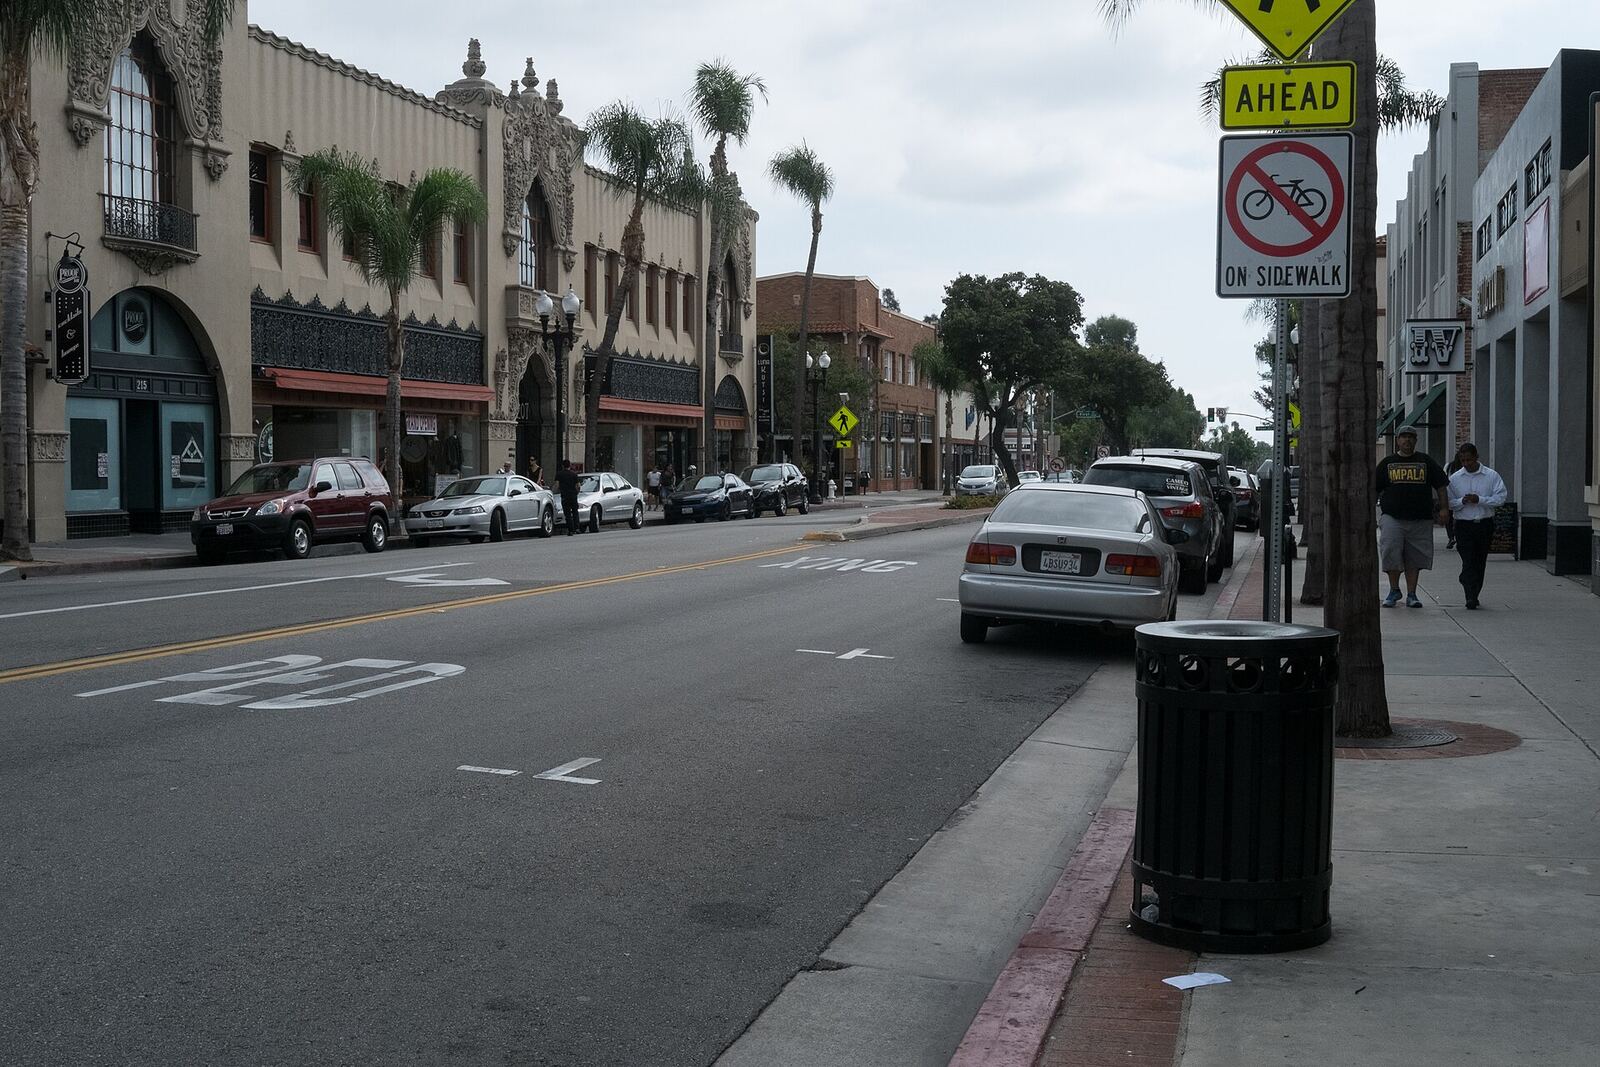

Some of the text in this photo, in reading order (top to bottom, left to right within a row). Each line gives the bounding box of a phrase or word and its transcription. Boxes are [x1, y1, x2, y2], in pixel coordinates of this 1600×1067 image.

[1235, 80, 1340, 113] AHEAD
[59, 268, 80, 280] PROOF
[1225, 265, 1342, 287] ON SIDEWALK
[125, 310, 144, 327] PROOF
[66, 328, 76, 339] &
[1410, 325, 1462, 366] IV
[136, 380, 148, 391] 215
[1389, 468, 1425, 481] IMPALA
[1166, 478, 1189, 486] CAMEO
[757, 556, 918, 573] XING
[1042, 558, 1078, 570] 4BSU934
